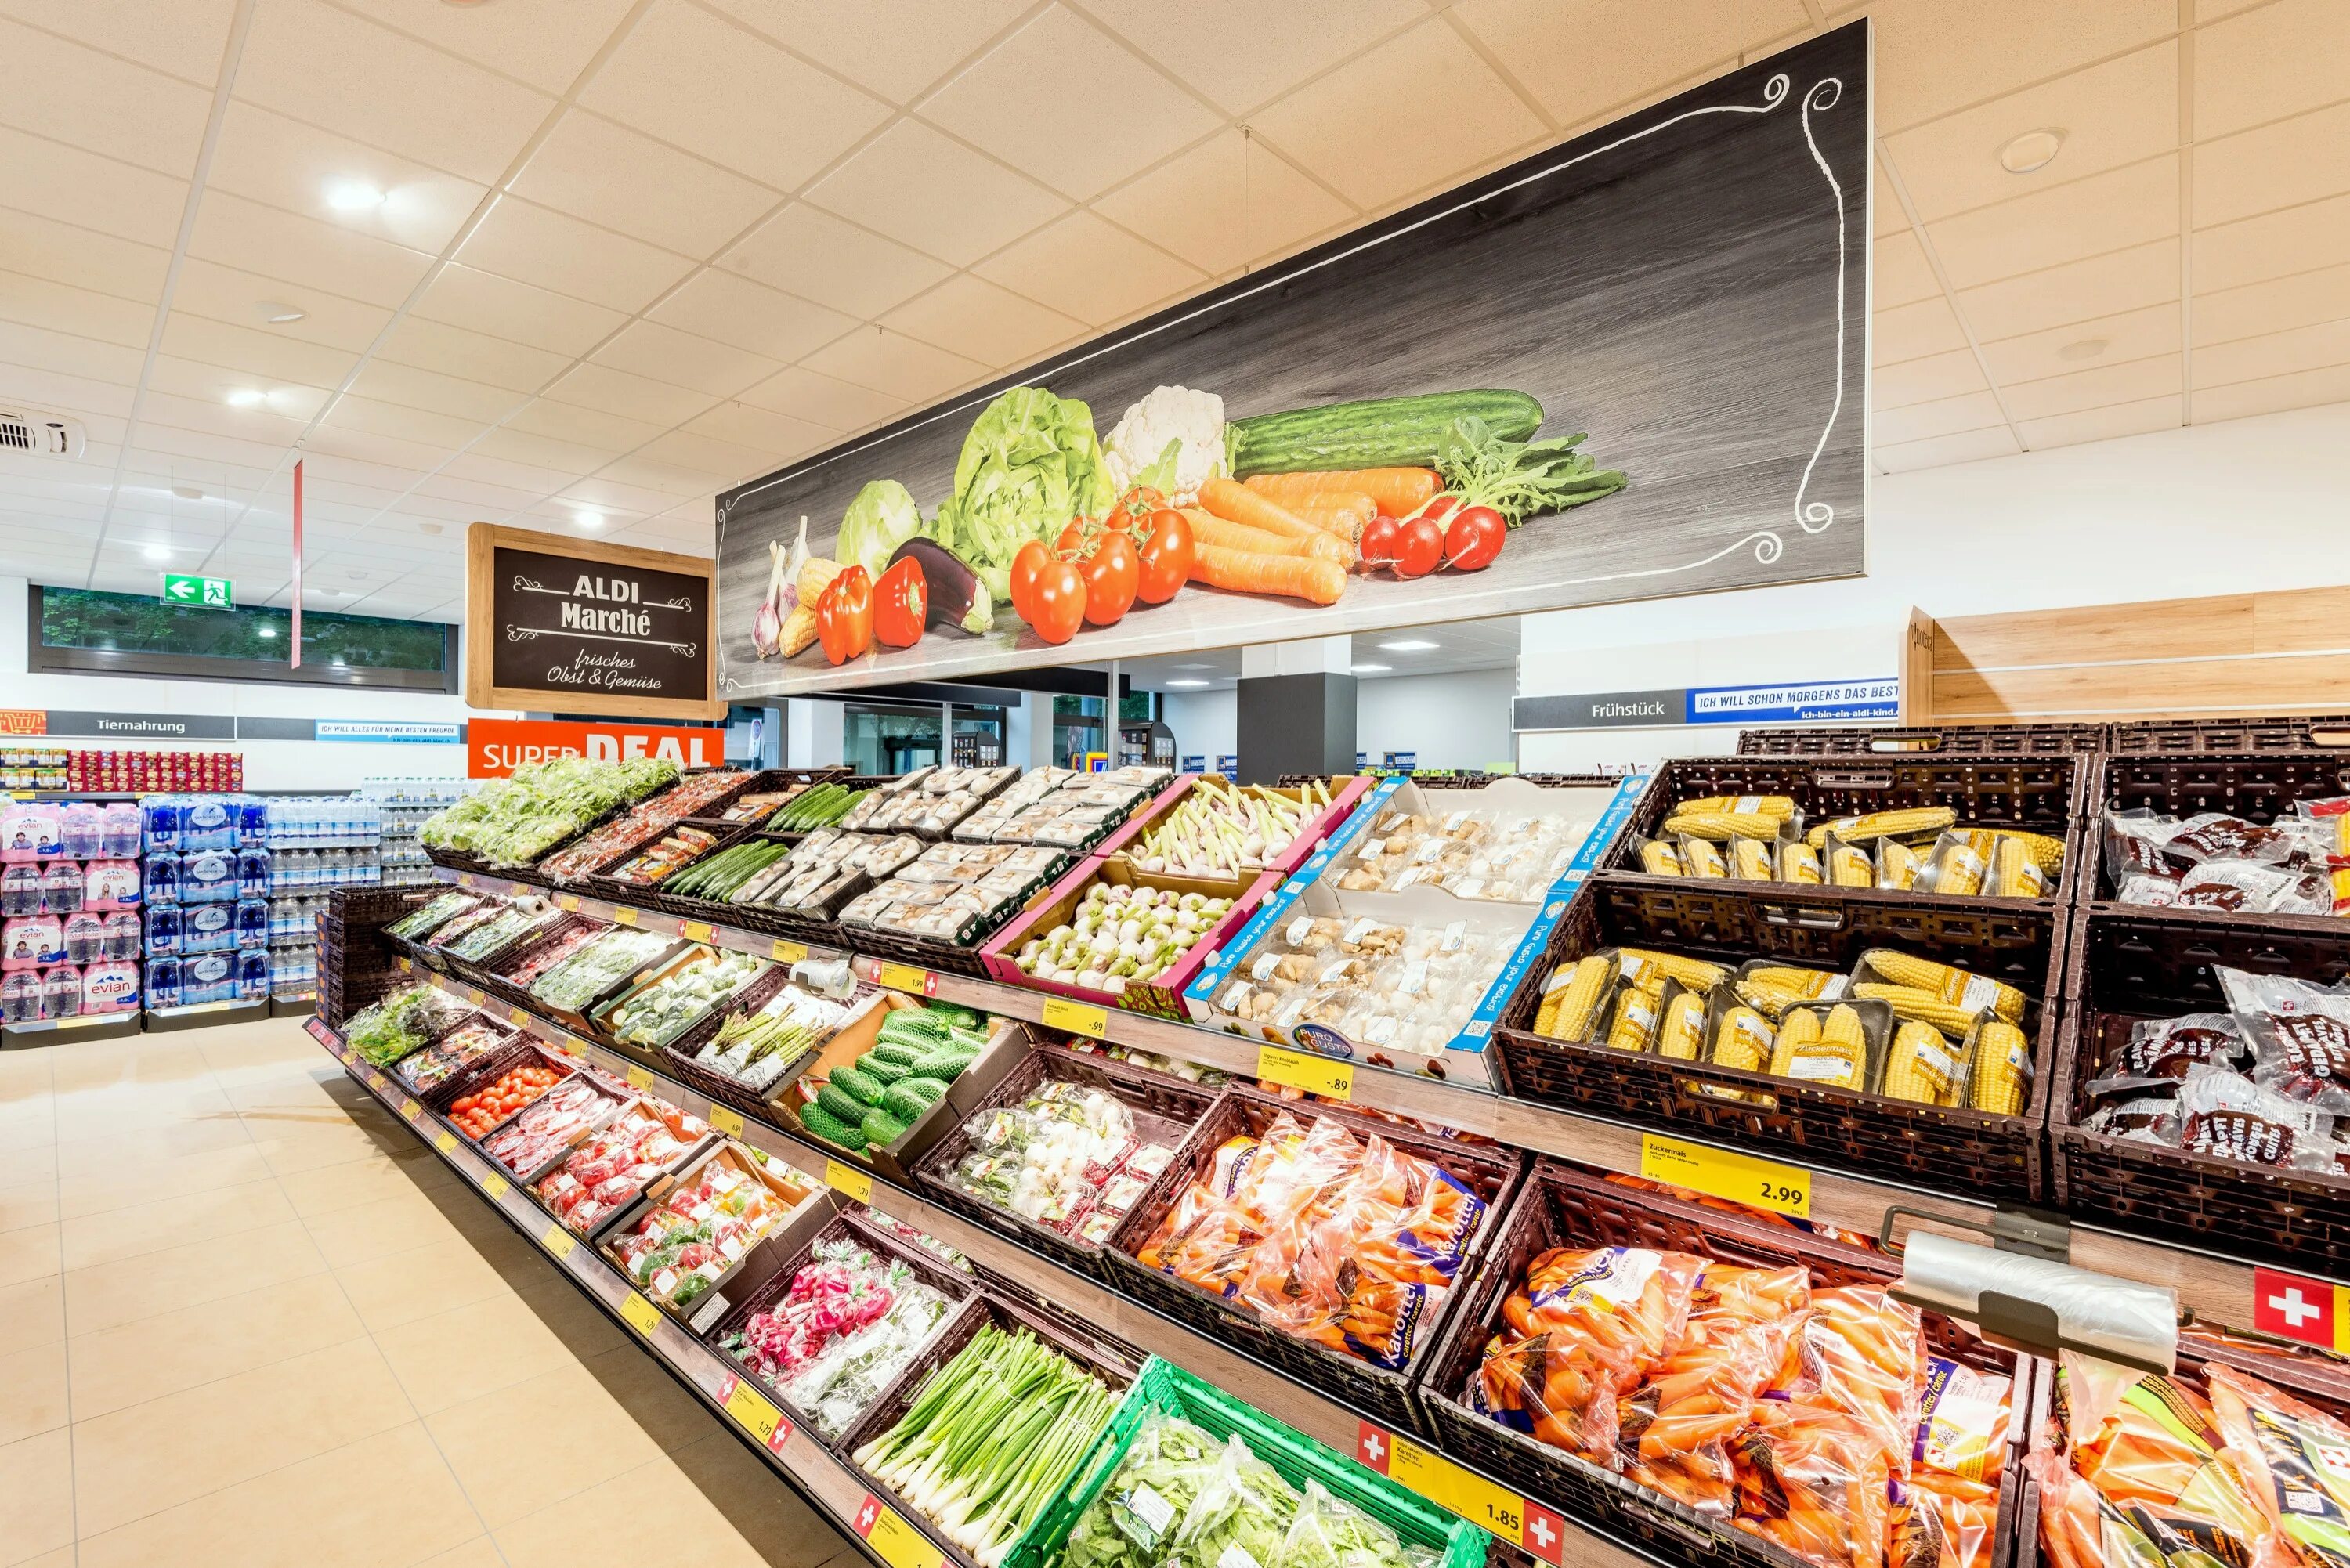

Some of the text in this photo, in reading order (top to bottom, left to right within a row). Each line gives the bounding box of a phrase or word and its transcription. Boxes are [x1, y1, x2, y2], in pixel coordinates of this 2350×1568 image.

[573, 575, 638, 604] ALDI
[561, 602, 651, 636] Marché
[574, 648, 636, 670] frisches
[547, 665, 662, 689] Obst & Gemüse
[1698, 697, 1716, 708] ICH
[1719, 695, 1744, 706] WILL
[1748, 692, 1784, 705] SCHON
[1787, 689, 1840, 703] MORGENS
[1844, 687, 1867, 699] DAS
[1592, 701, 1665, 718] Frühstück
[96, 718, 186, 735] Tiernahrung
[586, 734, 711, 768] DEAL
[18, 821, 43, 830] evian
[20, 930, 45, 938] evian
[1531, 925, 1549, 941] Puro
[1220, 954, 1235, 969] Puro
[1234, 934, 1253, 953] Gusto
[1252, 920, 1267, 935] your
[1517, 940, 1537, 965] Gusto
[1504, 962, 1522, 983] your
[91, 981, 131, 995] evian
[912, 979, 924, 988] 1.99
[1089, 1021, 1103, 1031] -.99
[1299, 1028, 1333, 1042] PURO
[1311, 1039, 1351, 1053] GUSTO
[1799, 1045, 1853, 1056] Zuckermais
[1279, 1057, 1300, 1065] Knoblauch
[1327, 1078, 1348, 1091] -.89
[1649, 1143, 1687, 1157] Zuckermais
[2263, 1126, 2282, 1161] CUITES
[857, 1185, 869, 1198] 1.79
[1760, 1182, 1803, 1205] 2.99
[1434, 1192, 1477, 1262] Karotten
[1457, 1232, 1472, 1256] carottes
[1470, 1209, 1482, 1229] carote
[1597, 1266, 1612, 1279] caro
[644, 1318, 656, 1331] 1.29
[1403, 1324, 1413, 1358] carottes
[1412, 1294, 1423, 1320] carote
[1919, 1393, 1936, 1425] carottes
[1932, 1370, 1948, 1392] carote
[757, 1420, 772, 1436] 1.79
[1397, 1446, 1420, 1461] Karotten
[1486, 1504, 1520, 1530] 1.85
